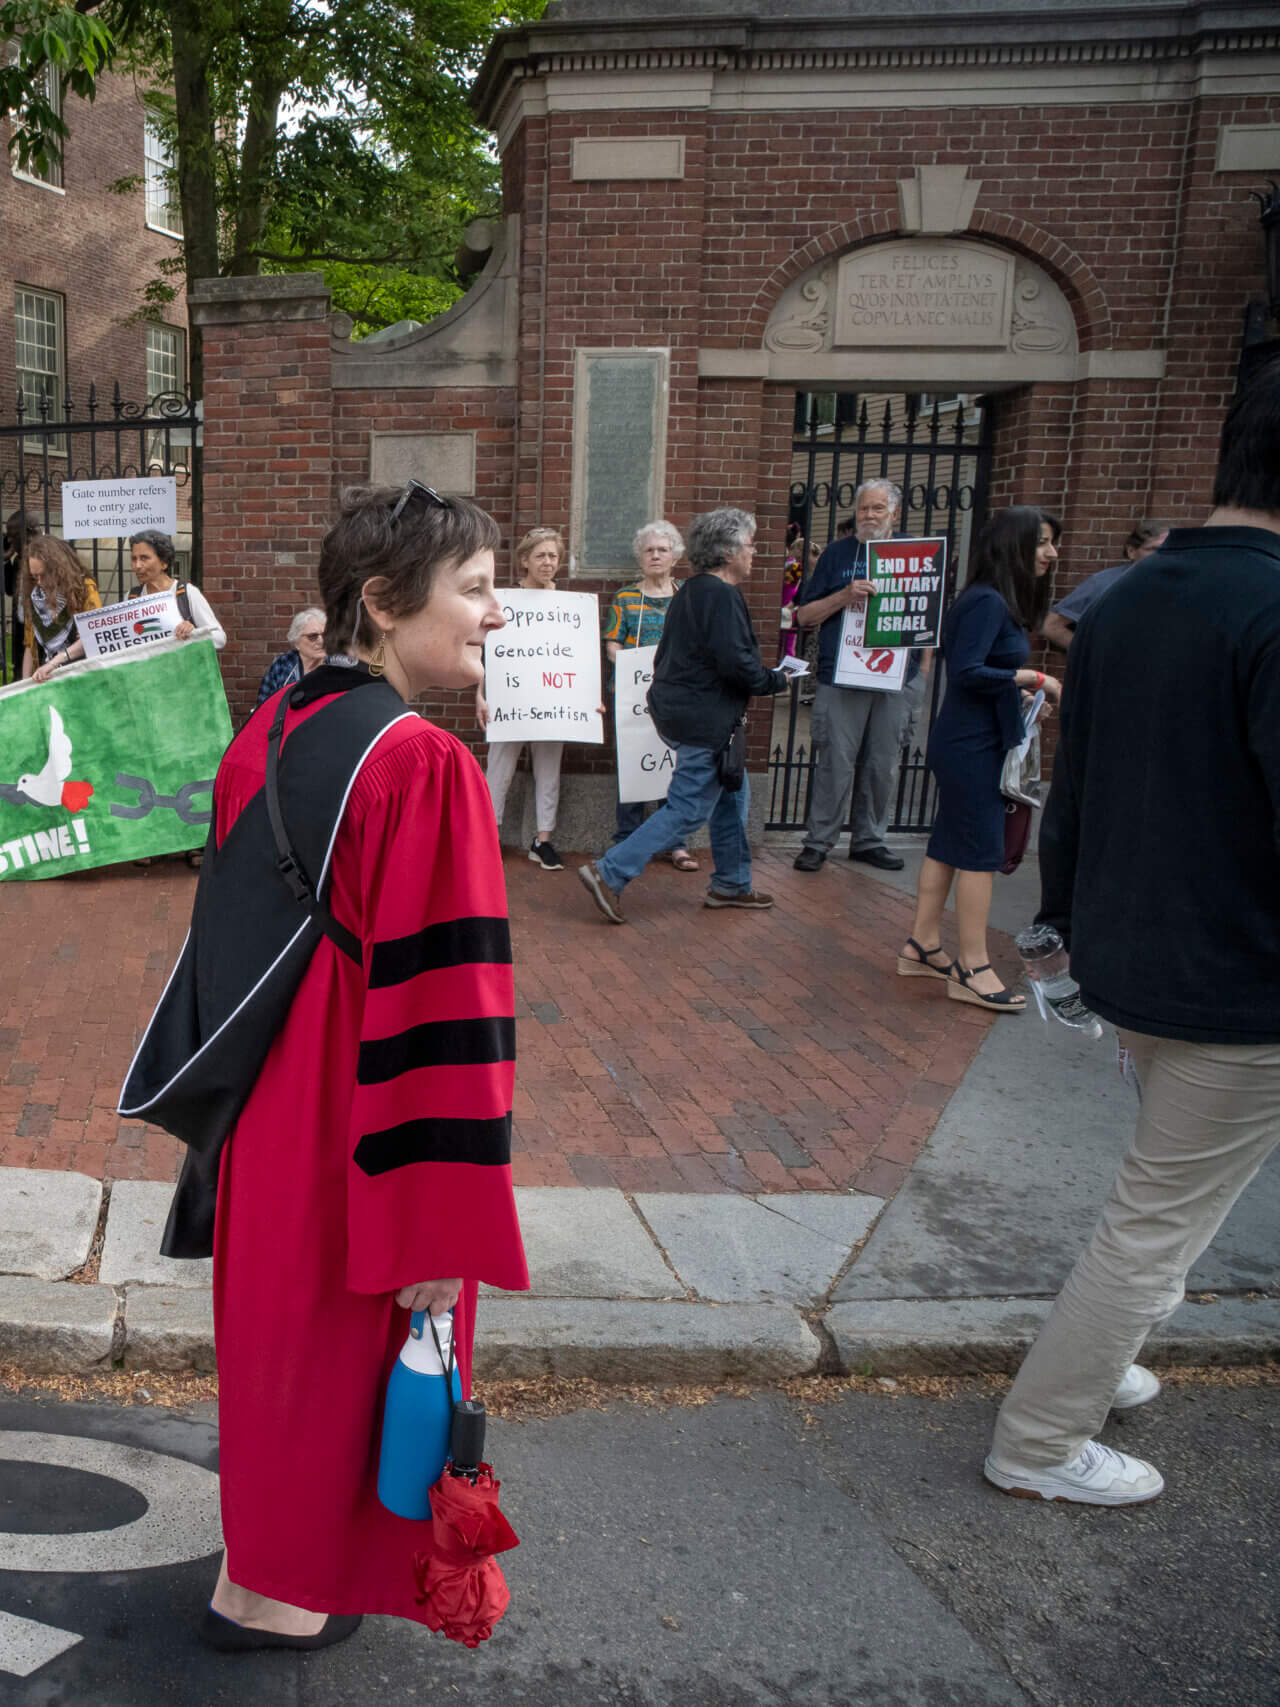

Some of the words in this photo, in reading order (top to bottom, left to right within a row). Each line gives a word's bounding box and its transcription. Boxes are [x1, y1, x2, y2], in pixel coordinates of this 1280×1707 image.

[892, 256, 959, 270] FELICES
[858, 274, 889, 288] TER
[896, 274, 916, 288] ET
[922, 274, 992, 288] AMPLIVS
[72, 488, 96, 499] Gate
[98, 486, 136, 497] number
[138, 486, 167, 496] refers
[87, 503, 97, 513] to
[99, 503, 125, 515] entry
[128, 502, 152, 514] gate,
[74, 518, 90, 528] not
[92, 517, 128, 529] seating
[130, 514, 165, 526] section
[876, 558, 905, 574] END
[909, 556, 937, 573] U.S.
[872, 576, 940, 593] MILITARY
[879, 597, 905, 613] AID
[909, 596, 928, 612] TO
[87, 609, 140, 630] CEASEFIRE
[141, 602, 168, 617] NOW!
[502, 606, 581, 629] Opposing
[876, 615, 927, 632] ISRAEL
[94, 626, 130, 644] FREE
[845, 635, 864, 647] GAZ
[494, 642, 575, 658] Genocide
[506, 672, 520, 688] is
[542, 671, 577, 688] NOT
[493, 706, 589, 722] Anti-Semitism
[640, 749, 674, 772] GA
